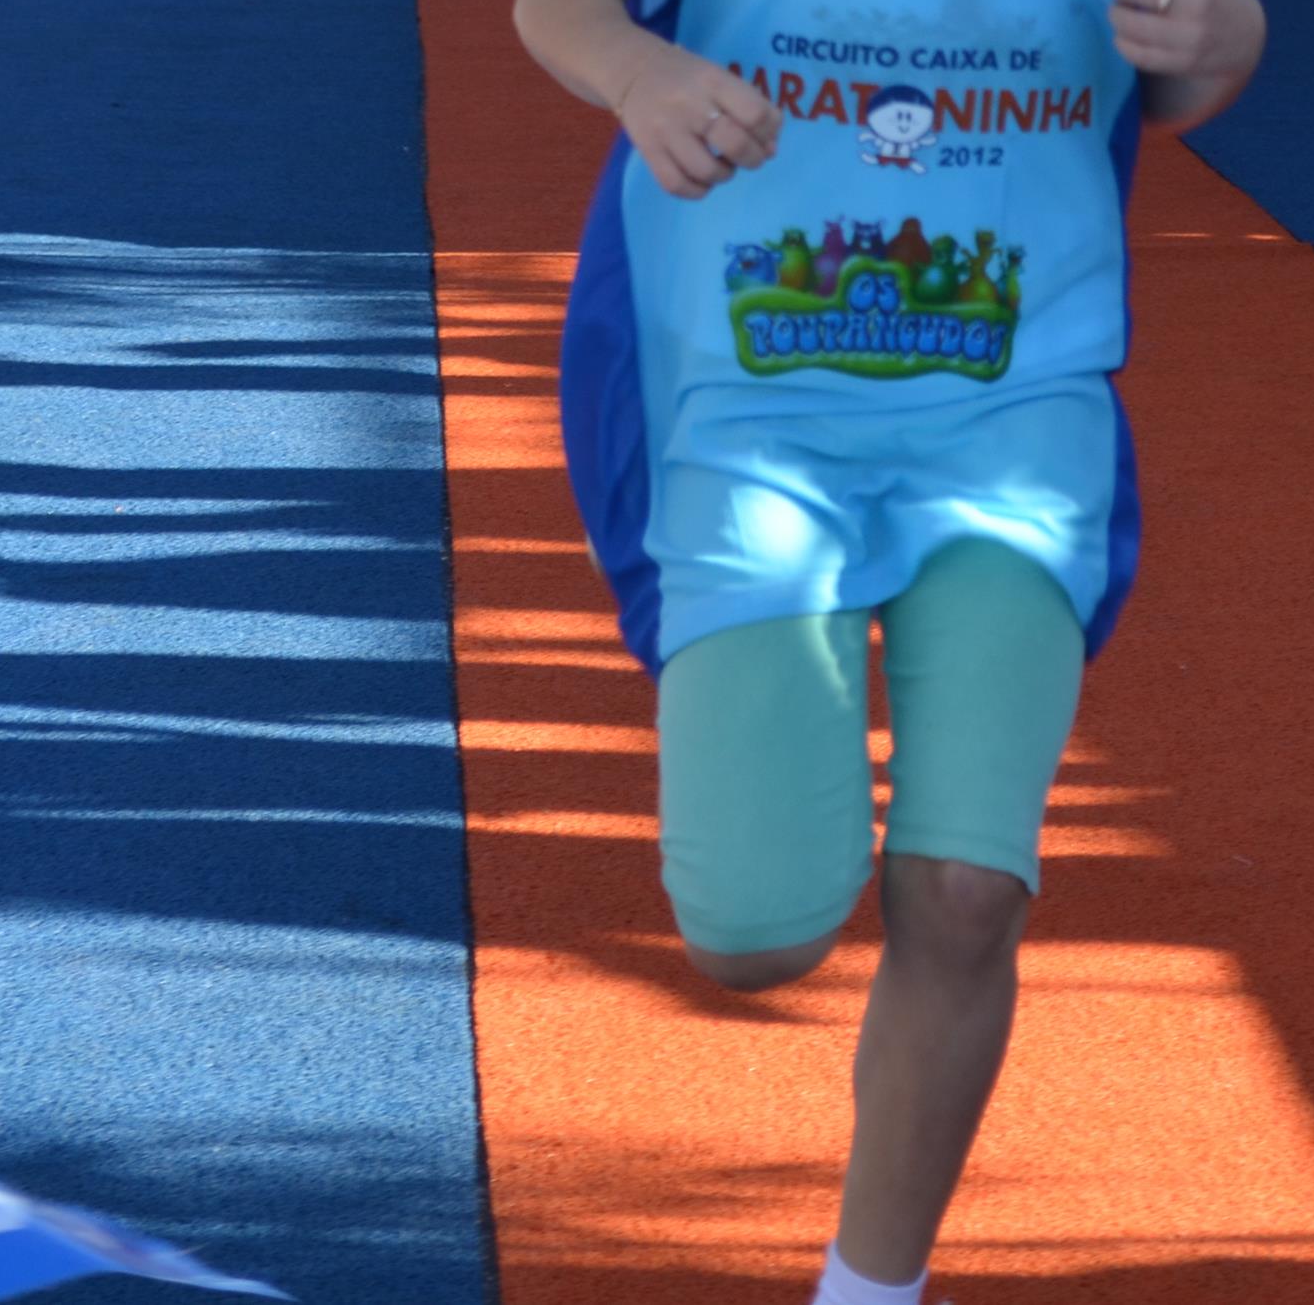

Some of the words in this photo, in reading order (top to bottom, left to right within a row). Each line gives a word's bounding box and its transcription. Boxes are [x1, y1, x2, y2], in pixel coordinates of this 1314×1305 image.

[771, 32, 899, 69] CIRCUITO
[910, 47, 999, 71] CAIXA
[1008, 49, 1043, 71] DE
[726, 61, 1091, 134] ARATONINHA
[938, 146, 1005, 168] 2012
[847, 271, 900, 313] OS
